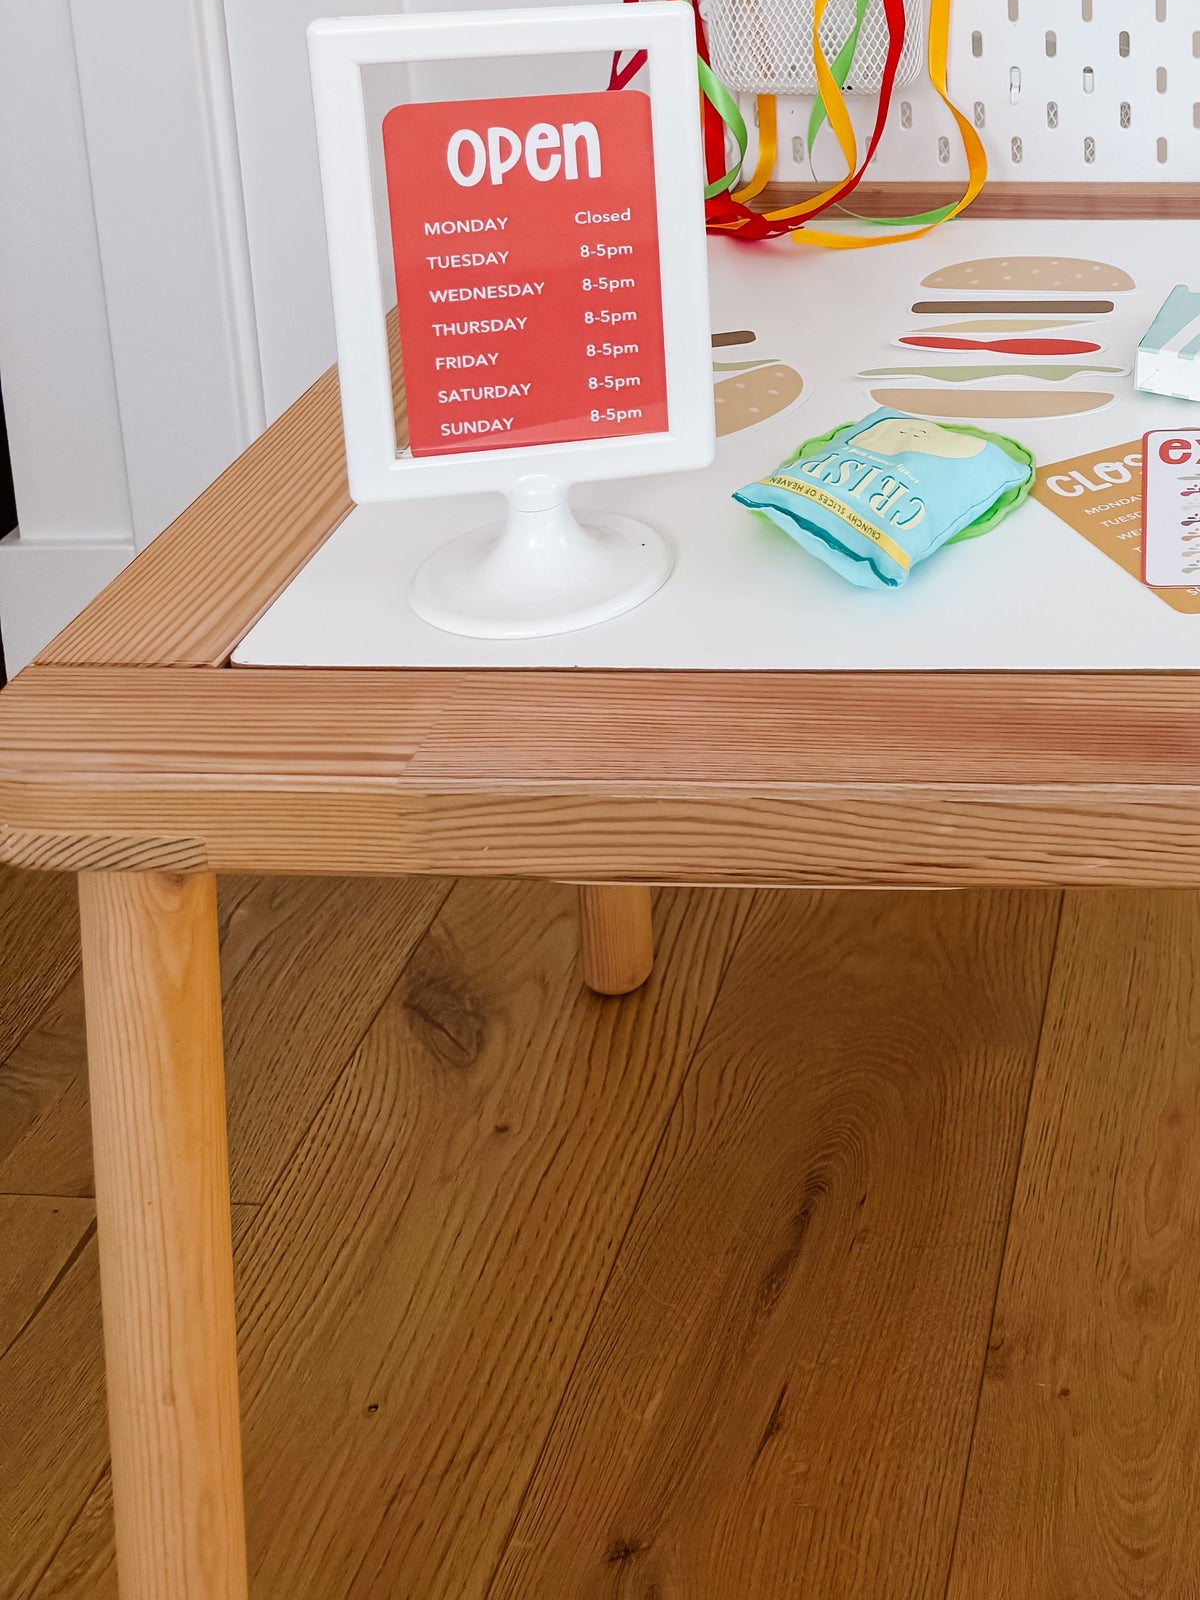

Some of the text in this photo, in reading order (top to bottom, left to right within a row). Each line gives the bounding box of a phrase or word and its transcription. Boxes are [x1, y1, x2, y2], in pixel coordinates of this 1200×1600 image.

[424, 207, 632, 237] MONDAY Closed
[426, 241, 634, 270] TUESDAY 8-5pm
[428, 275, 636, 304] WEDNESDAY 8-5pm
[432, 308, 638, 338] THURSDAY 8-5pm
[434, 341, 640, 371] FRIDAY 8-5pm
[437, 373, 642, 405] SATURDAY 8-5pm
[440, 405, 643, 437] SUNDAY 8-5pm
[1046, 453, 1143, 498] CLOS
[800, 453, 926, 531] CRISP
[768, 476, 882, 540] CRUNCHY SLICES OF HEAVEN
